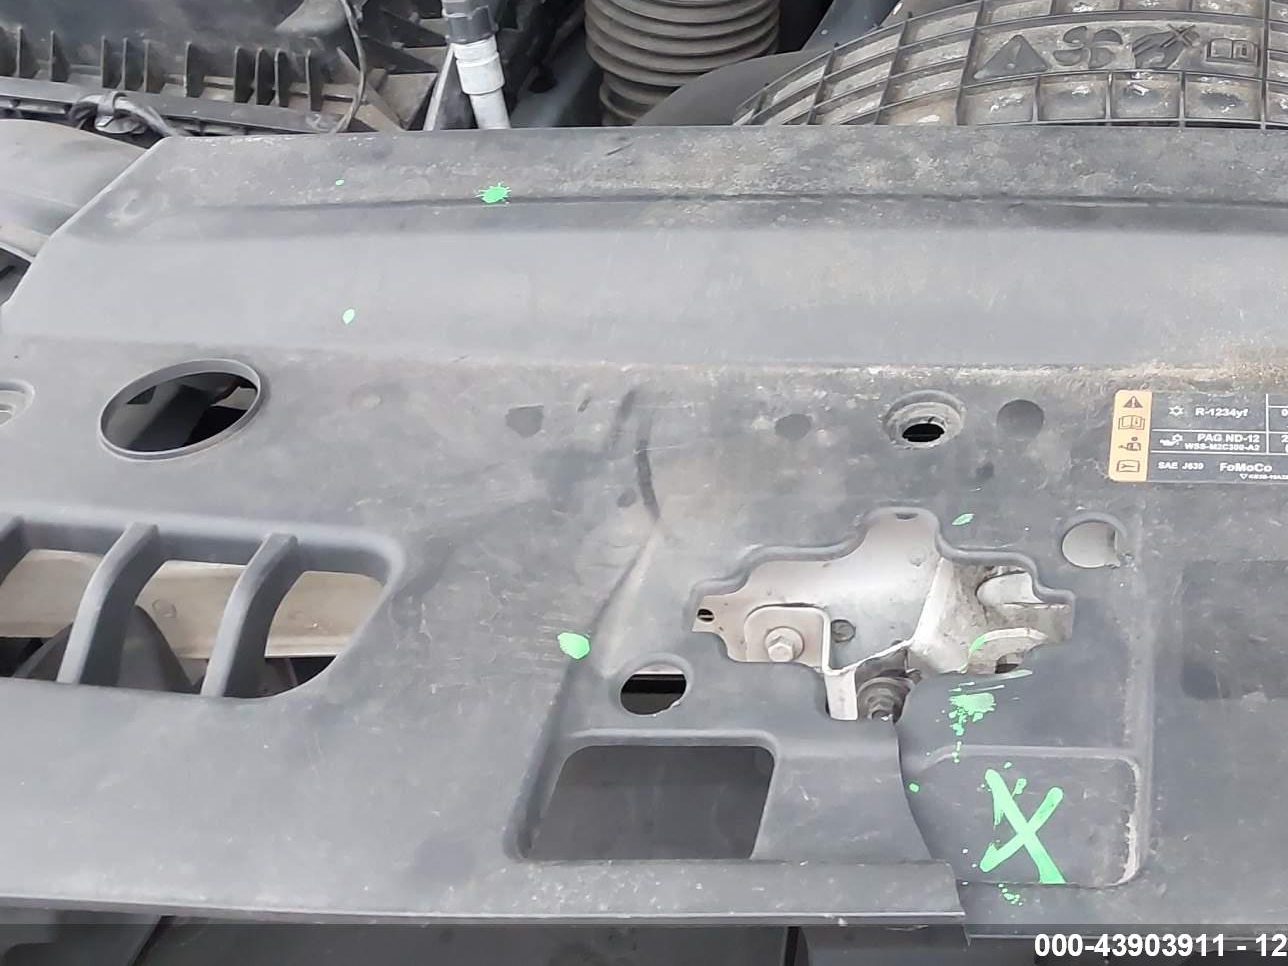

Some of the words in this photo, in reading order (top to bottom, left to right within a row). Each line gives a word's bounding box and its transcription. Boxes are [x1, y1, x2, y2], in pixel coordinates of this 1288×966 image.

[1195, 407, 1248, 418] R-1234yf
[1196, 433, 1223, 443] PAG
[1225, 434, 1260, 443] ND-12
[1158, 461, 1178, 470] SAE
[1219, 462, 1273, 473] FoMoCo
